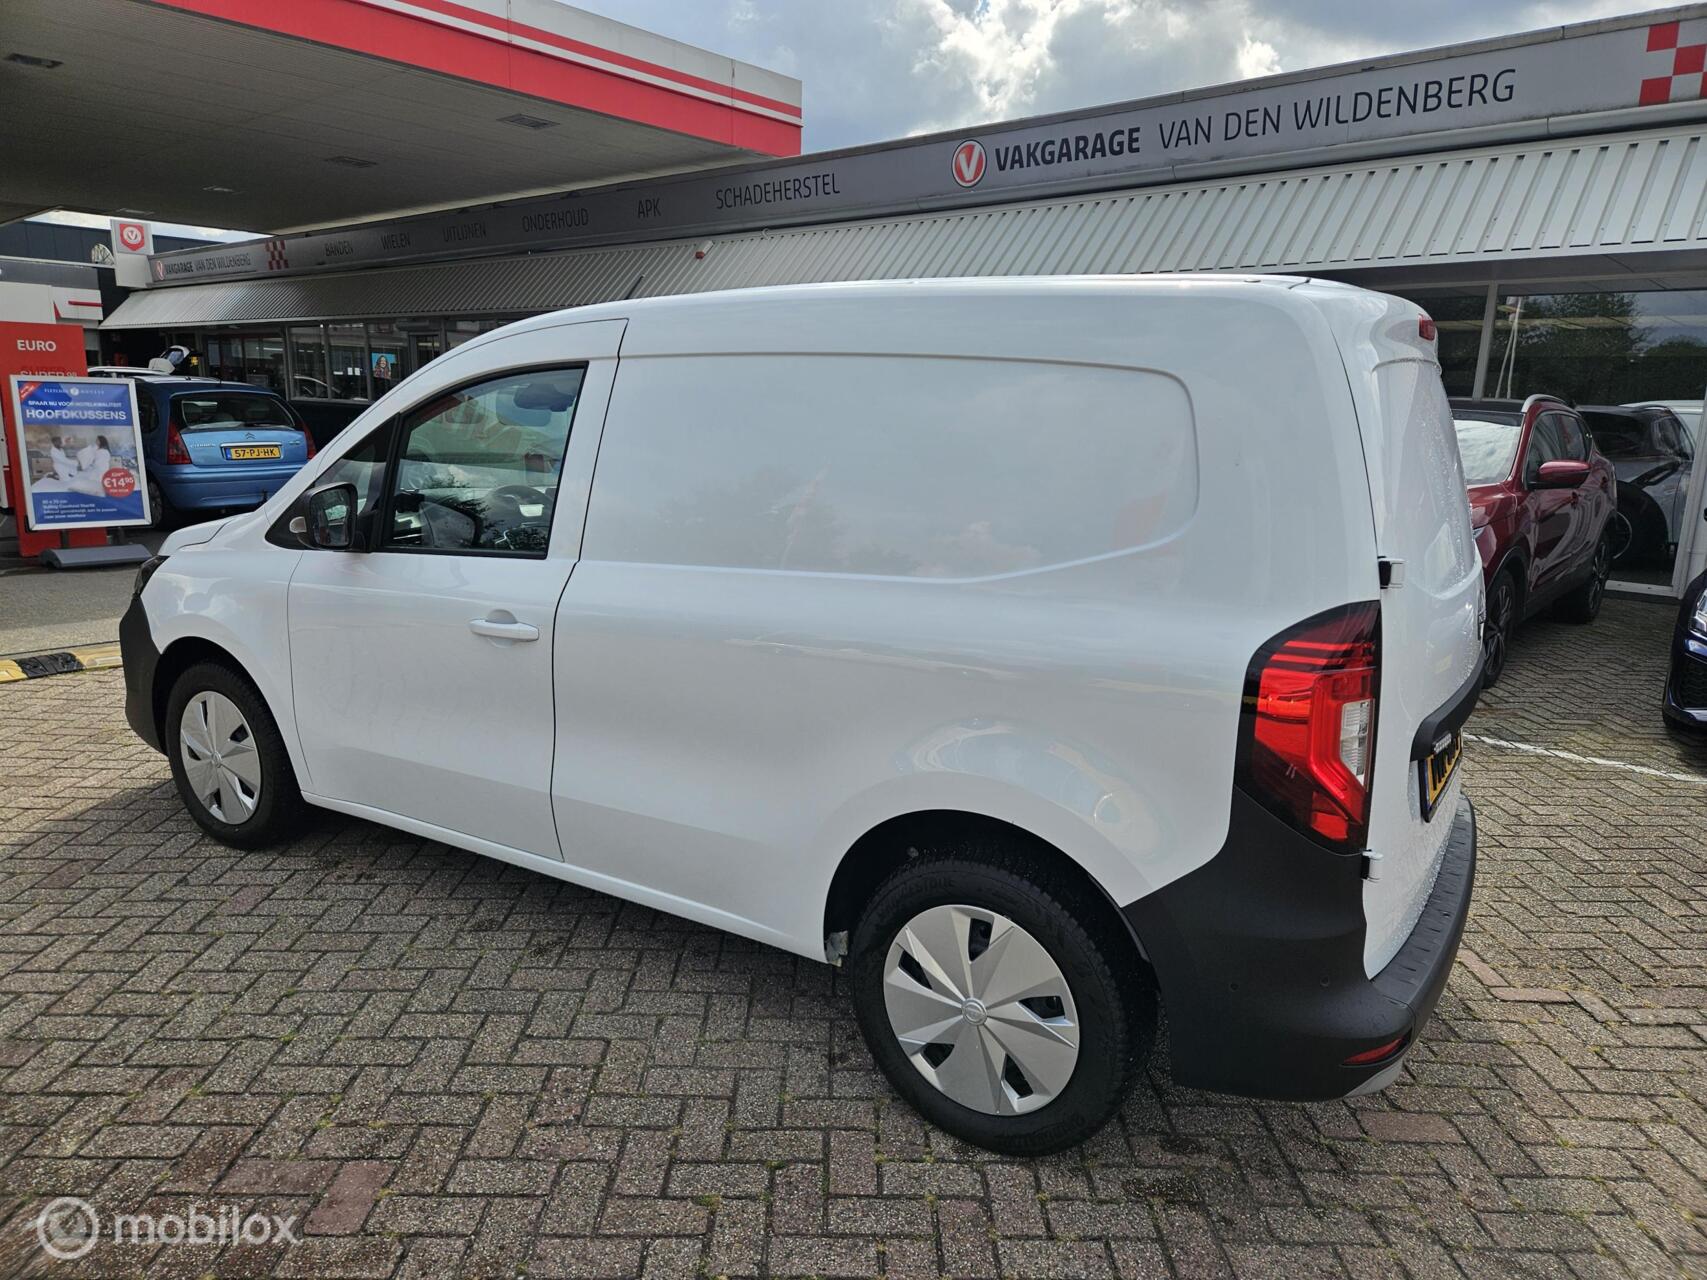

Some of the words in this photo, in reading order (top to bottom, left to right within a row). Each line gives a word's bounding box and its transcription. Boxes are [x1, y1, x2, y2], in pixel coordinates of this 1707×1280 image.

[994, 126, 1141, 171] VAKGARAGE
[1158, 116, 1212, 149] VAN
[1224, 104, 1281, 141] DEN
[1293, 69, 1516, 130] WILDENBERG
[715, 172, 841, 210] SCHADEHERSTEL
[637, 197, 662, 219] APK
[521, 208, 590, 233] ONDERHOUD
[380, 232, 411, 250] WIELEN
[442, 222, 487, 243] UITLIJNEN
[324, 239, 354, 257] BANDEN
[166, 261, 194, 275] VAKGARAGE
[206, 257, 217, 270] DEN
[217, 253, 251, 270] WILDENBERG
[17, 339, 57, 352] EURO
[26, 409, 127, 420] HOOFDKUSSENS
[234, 448, 277, 458] 57-PJ-HK
